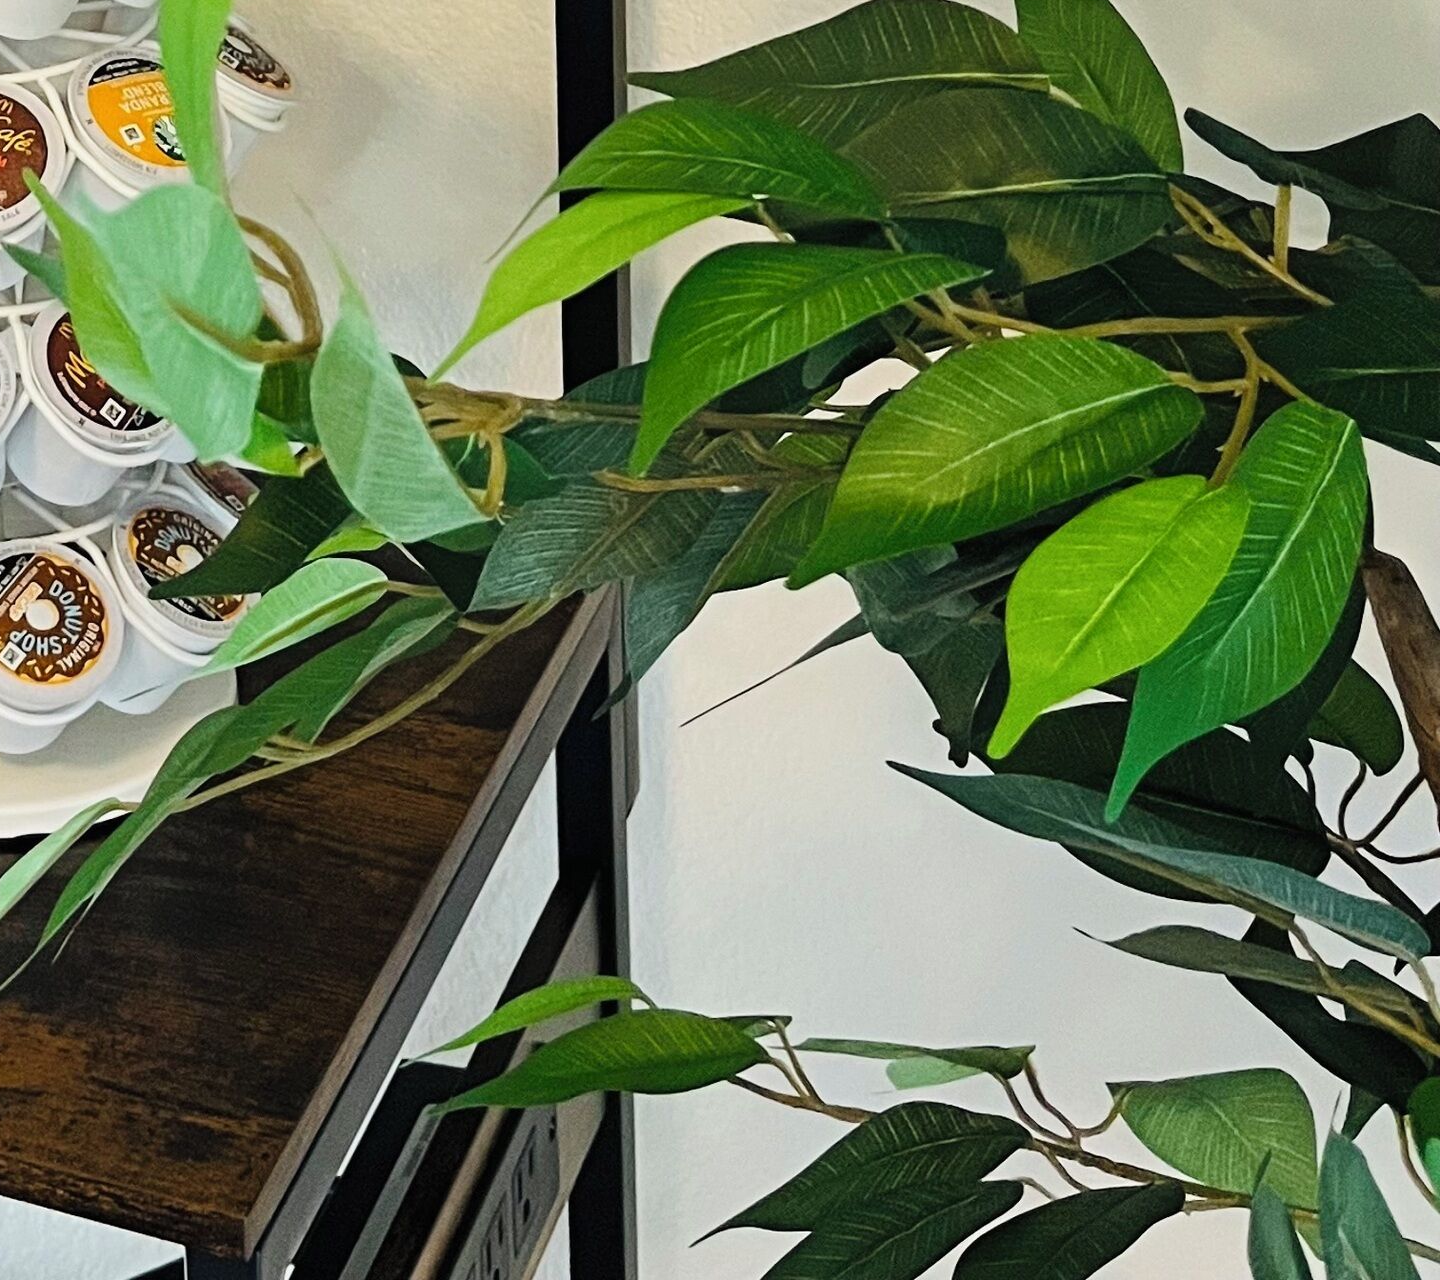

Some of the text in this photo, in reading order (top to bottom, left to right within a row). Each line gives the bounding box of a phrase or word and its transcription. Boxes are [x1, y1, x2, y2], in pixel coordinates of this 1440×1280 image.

[154, 525, 201, 551] DONUT
[49, 580, 83, 645] DONUT
[10, 630, 63, 656] SHOP
[55, 622, 100, 672] ORIGINAL
